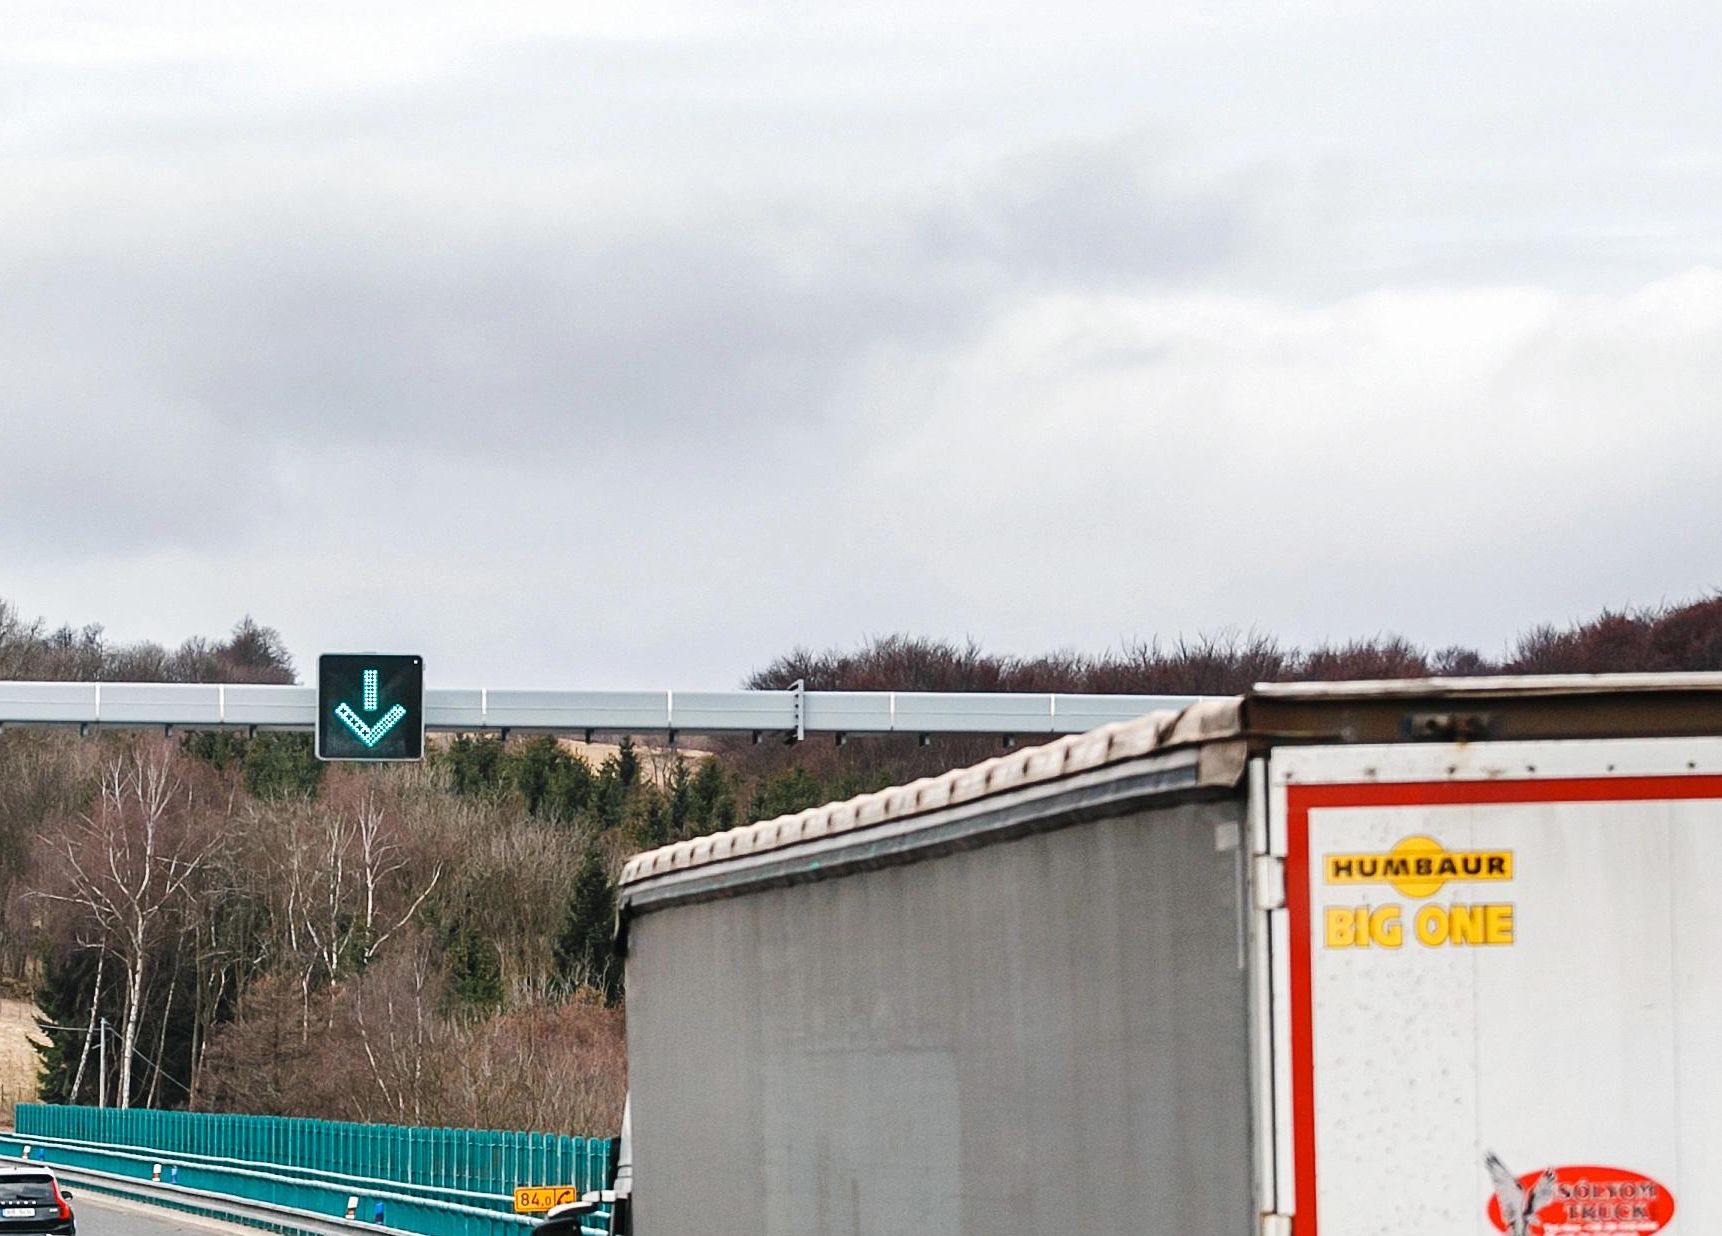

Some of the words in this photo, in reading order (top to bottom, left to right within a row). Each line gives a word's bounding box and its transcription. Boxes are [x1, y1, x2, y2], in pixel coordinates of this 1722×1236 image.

[1332, 855, 1507, 878] HUMBAUR
[1325, 905, 1402, 948] BIG
[1415, 903, 1515, 946] ONE
[521, 1192, 552, 1206] 84.0
[1567, 1202, 1649, 1221] TRUCK
